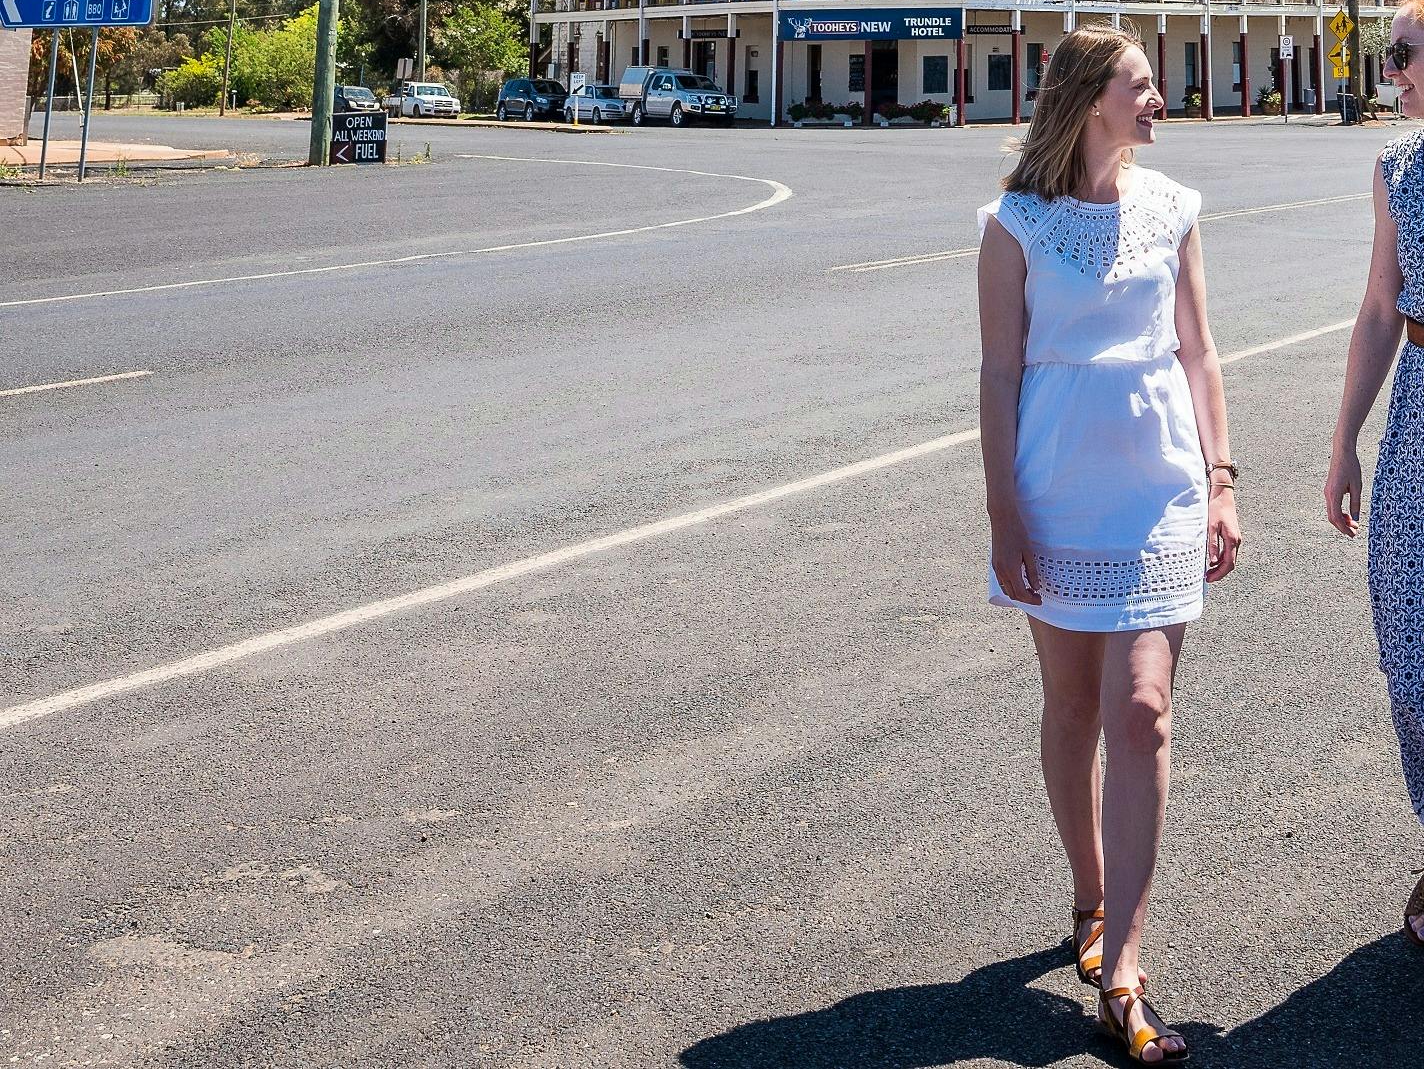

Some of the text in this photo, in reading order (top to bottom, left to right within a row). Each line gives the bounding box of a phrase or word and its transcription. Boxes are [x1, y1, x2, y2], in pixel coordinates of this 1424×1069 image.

[88, 5, 102, 14] BBQ
[812, 21, 892, 32] TOOHEYS NEW
[903, 17, 952, 26] TRUNDLE
[911, 27, 945, 36] HOTEL
[346, 116, 373, 128] OPEN
[334, 129, 385, 141] ALL WEEKEND
[355, 143, 379, 160] FUEL
